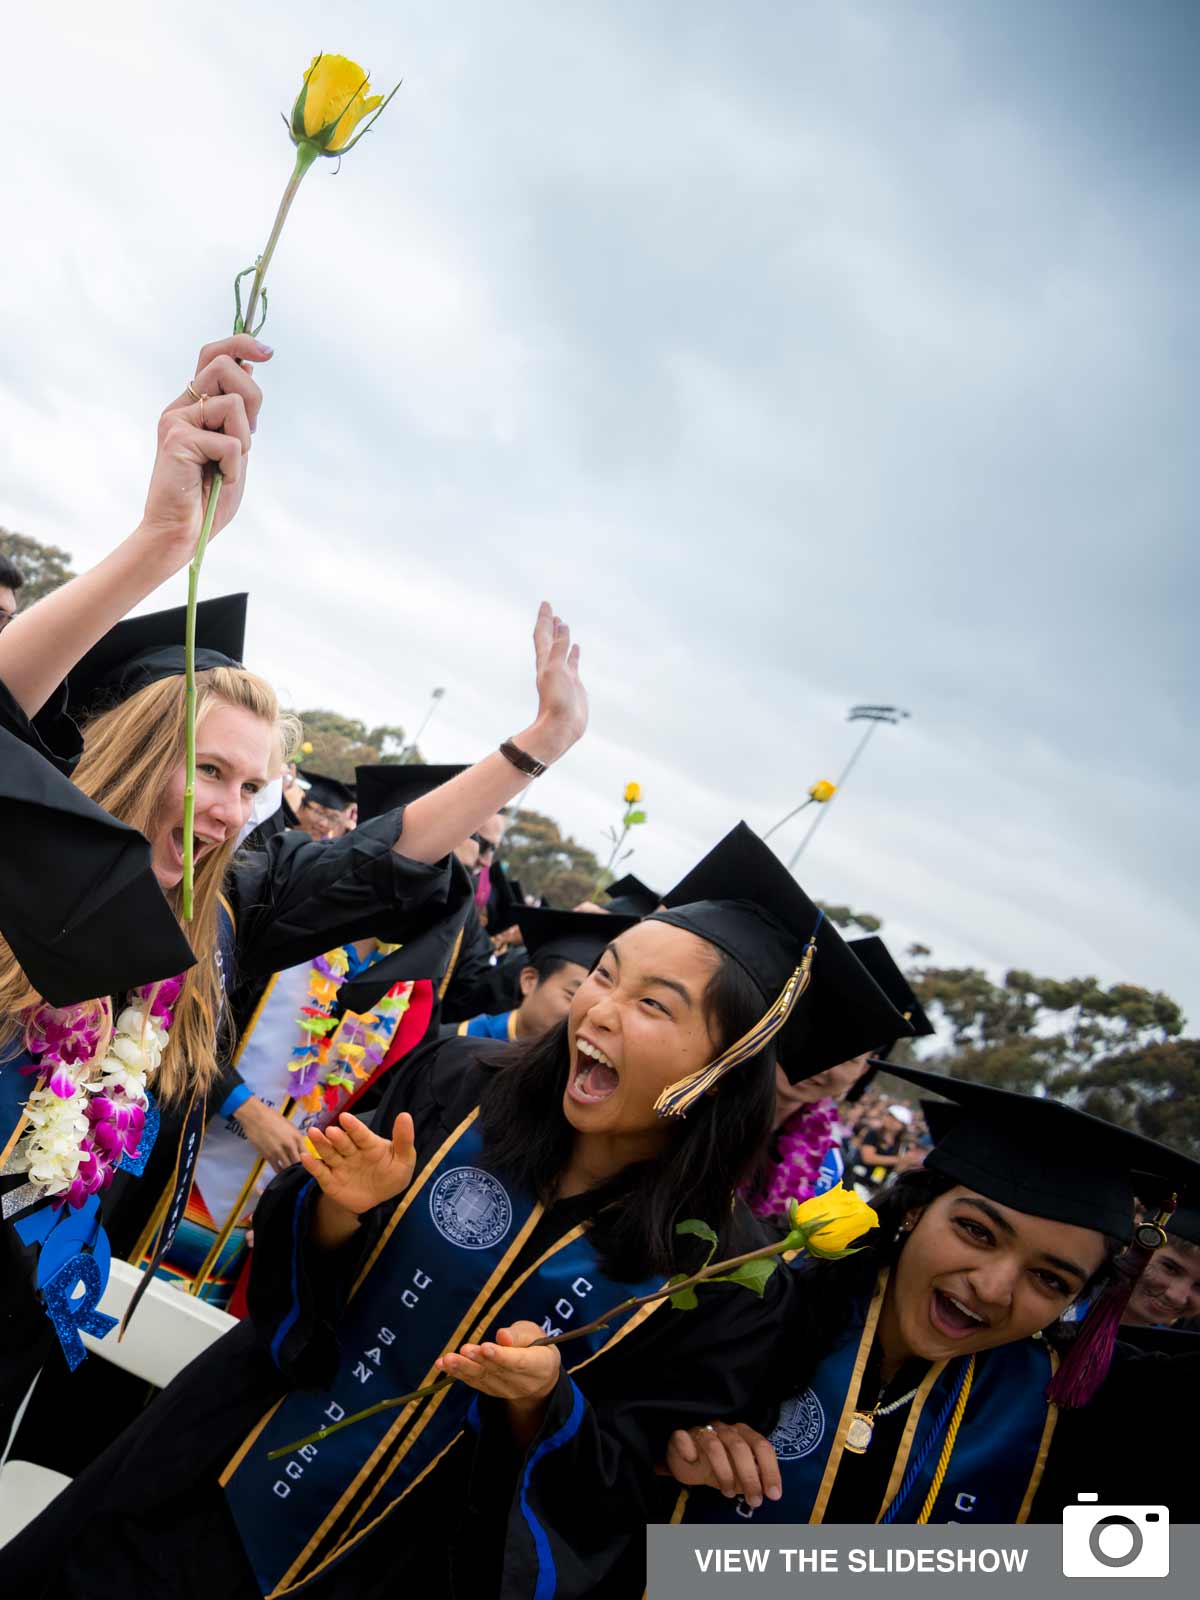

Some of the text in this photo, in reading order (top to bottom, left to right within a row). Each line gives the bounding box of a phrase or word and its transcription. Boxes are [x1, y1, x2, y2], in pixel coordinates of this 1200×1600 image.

[435, 1194, 444, 1213] THE
[441, 1171, 487, 1191] UNIVERSITY
[476, 1200, 508, 1245] CALIFORNIA
[401, 1268, 433, 1309] UC
[352, 1326, 397, 1384] SAN
[792, 1397, 820, 1453] CALIFORNIA
